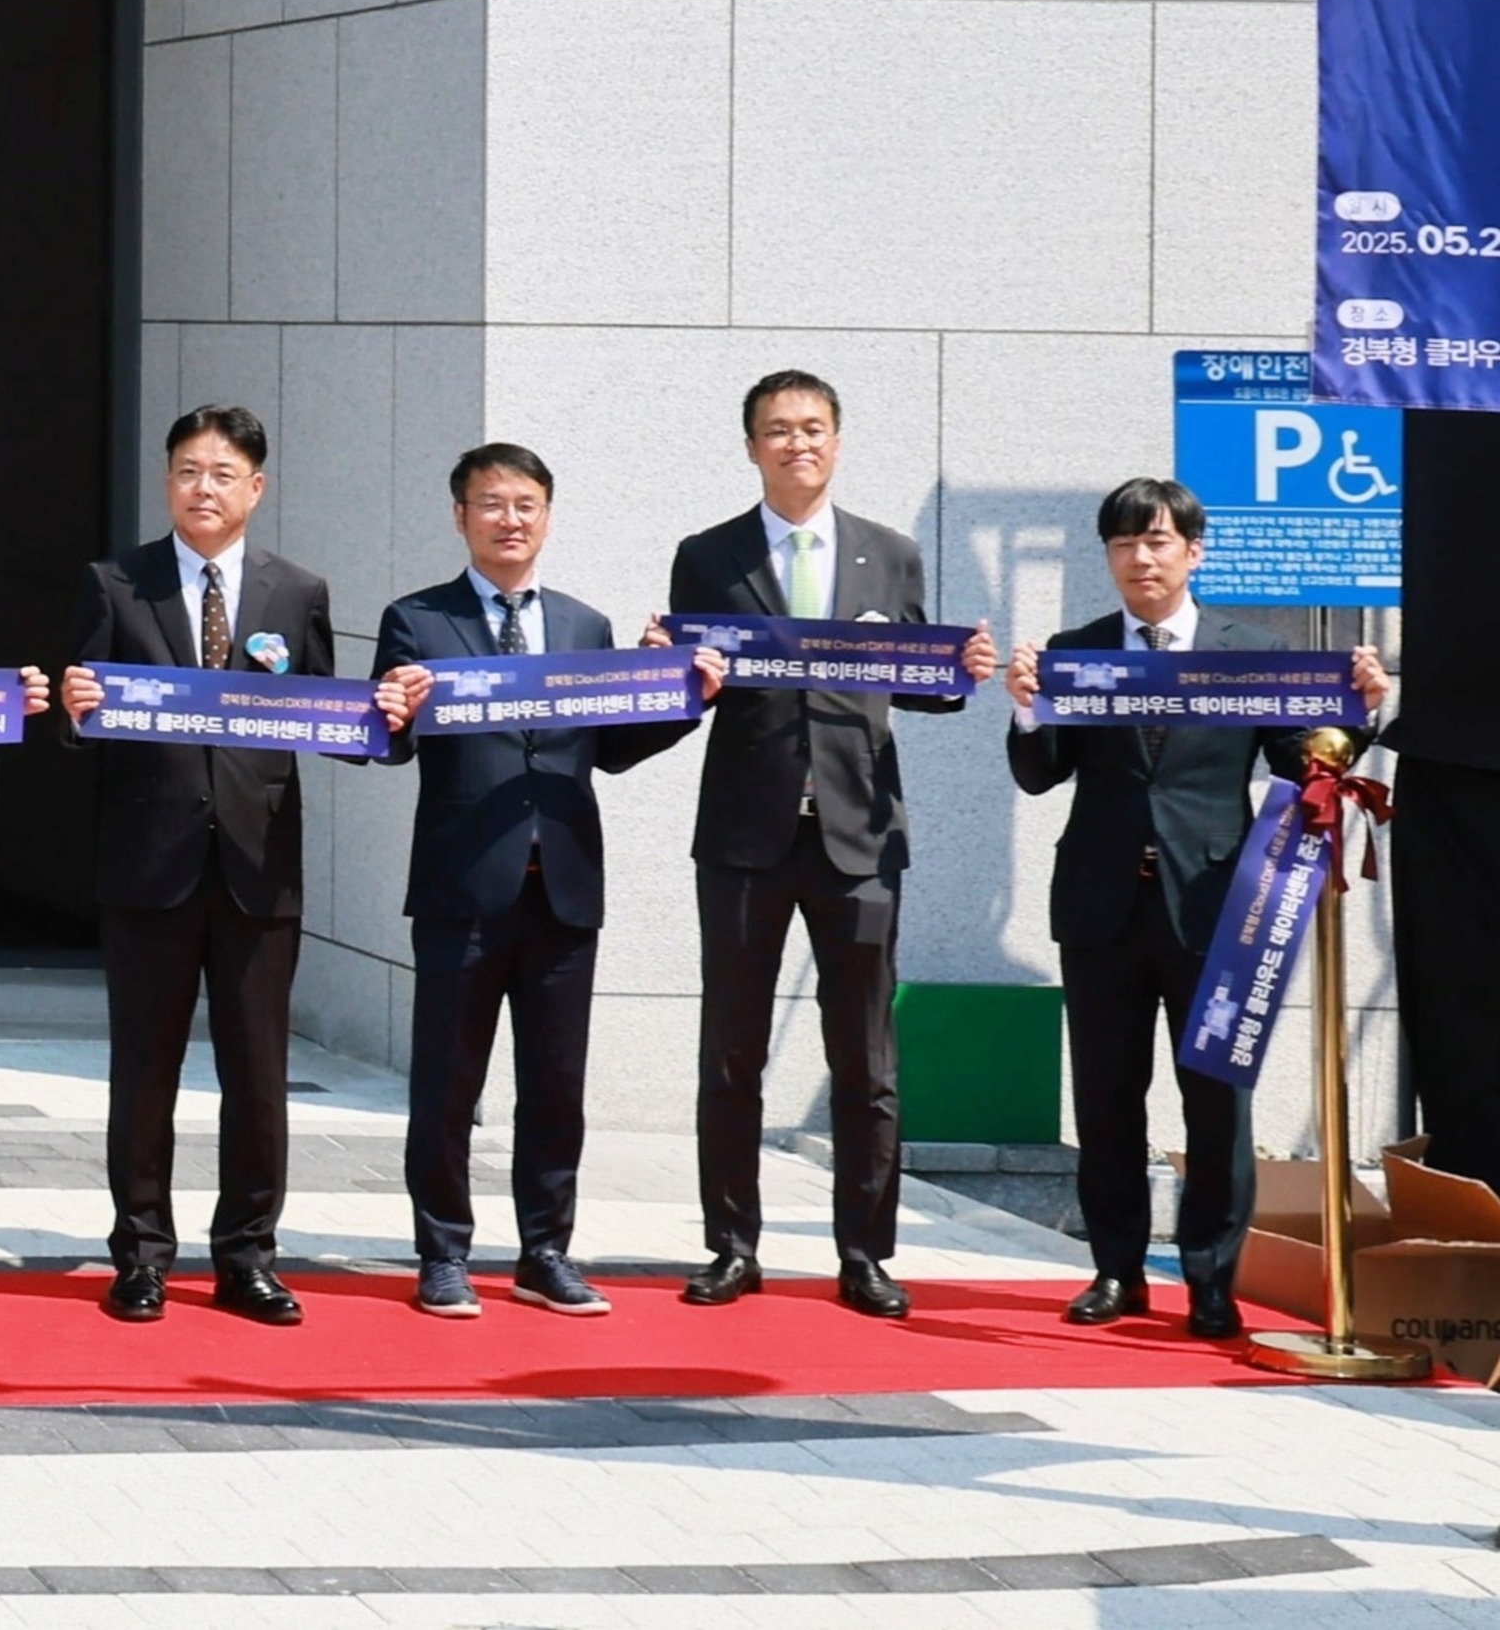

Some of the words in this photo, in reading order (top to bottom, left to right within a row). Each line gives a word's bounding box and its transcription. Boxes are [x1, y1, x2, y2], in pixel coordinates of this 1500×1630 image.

[1341, 231, 1414, 253] 2025.
[1418, 225, 1500, 256] 05.2
[1203, 355, 1308, 380] 장애인전
[1342, 337, 1417, 366] 경북형
[1425, 339, 1500, 368] 클라우
[1256, 410, 1322, 501] P
[435, 703, 483, 724] 경북형
[486, 700, 552, 721] 클라우드
[555, 693, 633, 716] 데이터센터
[637, 690, 685, 711] 준공식
[1053, 696, 1107, 716] 경북형
[1112, 696, 1185, 714] 클라우드
[1189, 696, 1281, 715] 데이터센터
[1285, 696, 1342, 715] 준공식
[100, 709, 151, 730] 경북형
[155, 712, 223, 733] 클라우드
[228, 717, 312, 740] 데이터센터
[316, 723, 368, 743] 준공식
